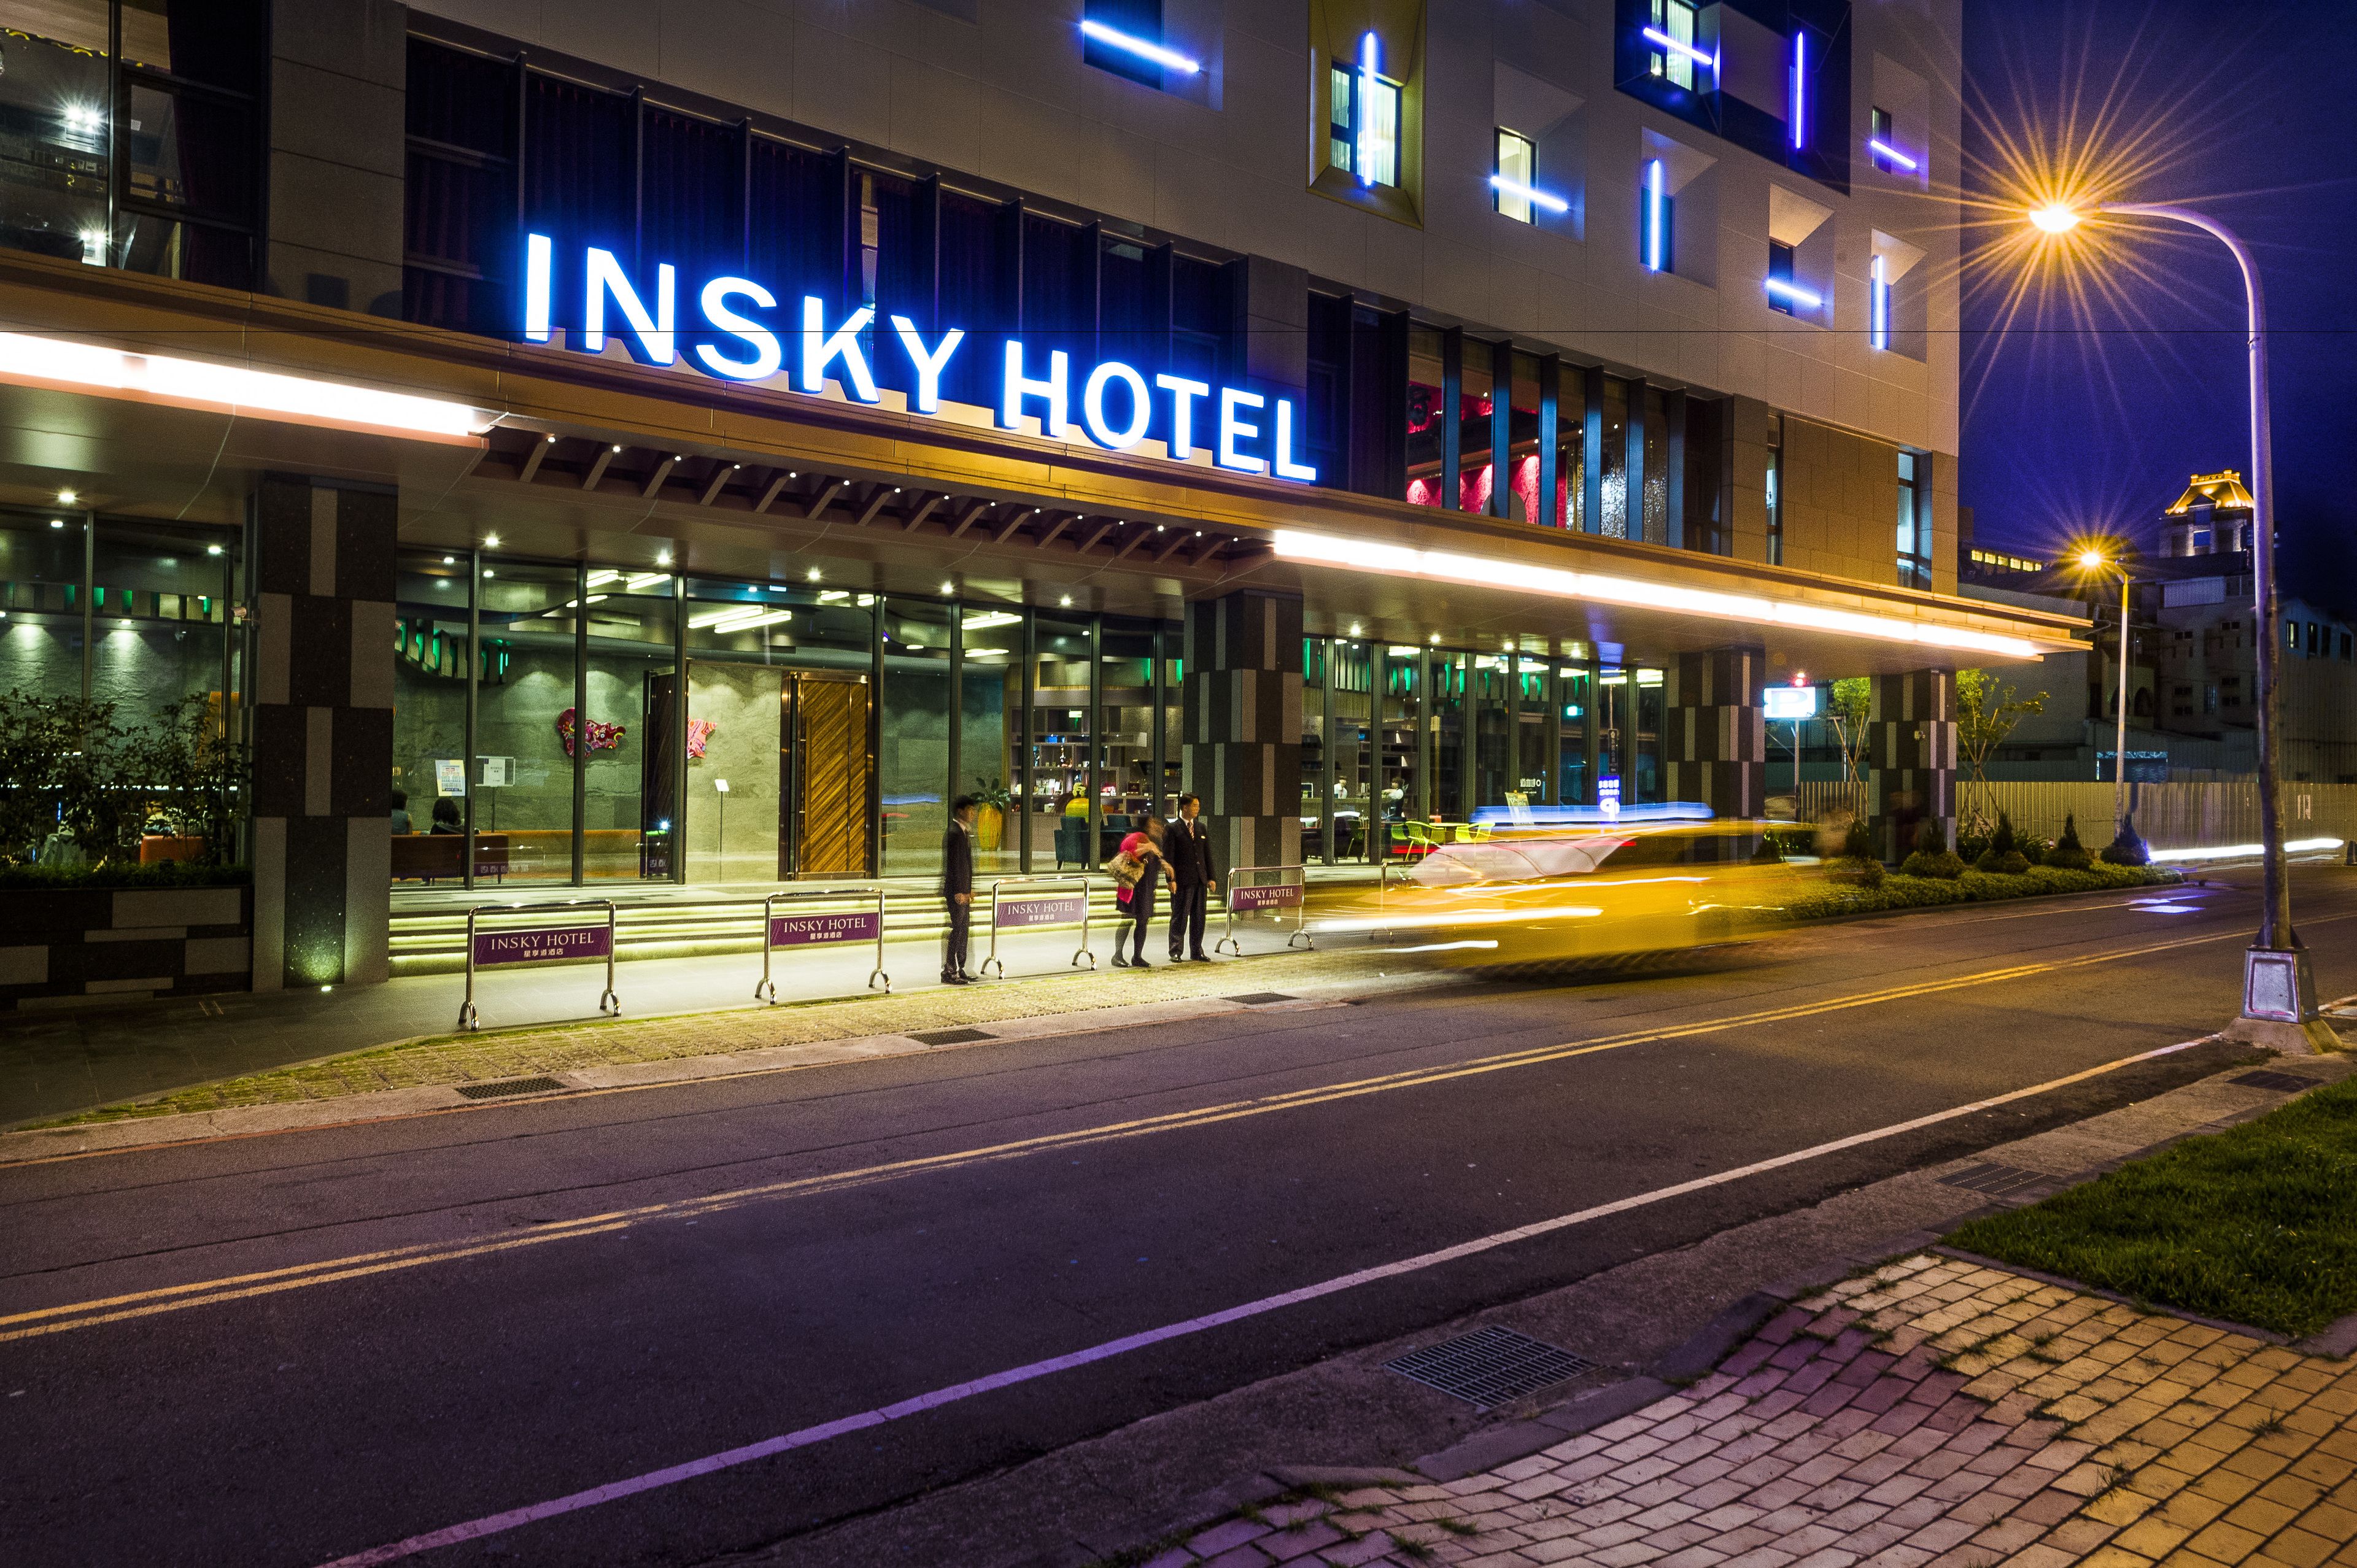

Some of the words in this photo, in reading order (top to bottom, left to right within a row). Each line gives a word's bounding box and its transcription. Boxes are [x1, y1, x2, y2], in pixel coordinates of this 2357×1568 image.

[525, 233, 964, 414] INSKY
[1005, 339, 1316, 481] HOTEL
[1771, 690, 1807, 714] P
[1241, 890, 1266, 900] INSKY
[1269, 888, 1293, 898] HOTEL
[1008, 903, 1039, 915] INSKY
[1043, 902, 1074, 913] HOTEL
[784, 921, 823, 933] INSKY
[829, 917, 866, 930] HOTEL
[492, 935, 540, 950] INSKY
[547, 932, 594, 946] HOTEL
